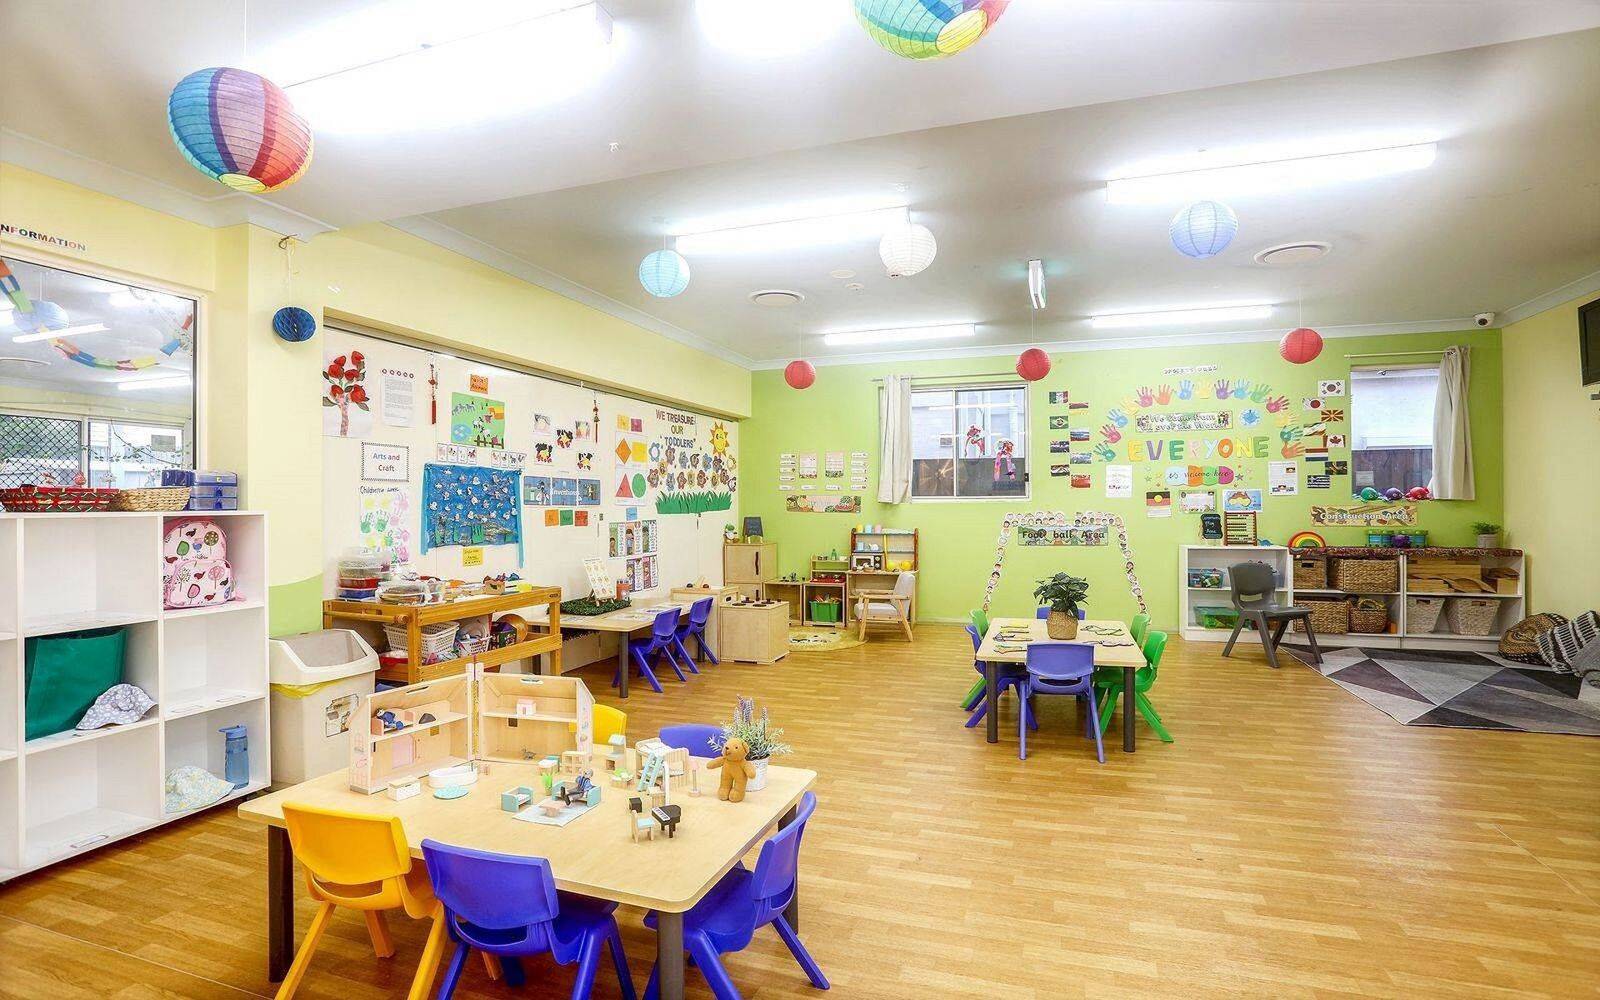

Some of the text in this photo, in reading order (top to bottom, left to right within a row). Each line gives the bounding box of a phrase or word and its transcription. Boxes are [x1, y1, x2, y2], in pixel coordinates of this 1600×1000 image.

[655, 409, 695, 426] WE TREASURE
[670, 424, 684, 435] OUR
[1128, 436, 1269, 461] EVERYONE
[373, 452, 387, 461] Arts
[378, 464, 395, 472] Craft
[1320, 511, 1409, 521] Construction Area
[1053, 530, 1073, 539] ball
[1081, 530, 1105, 539] Area
